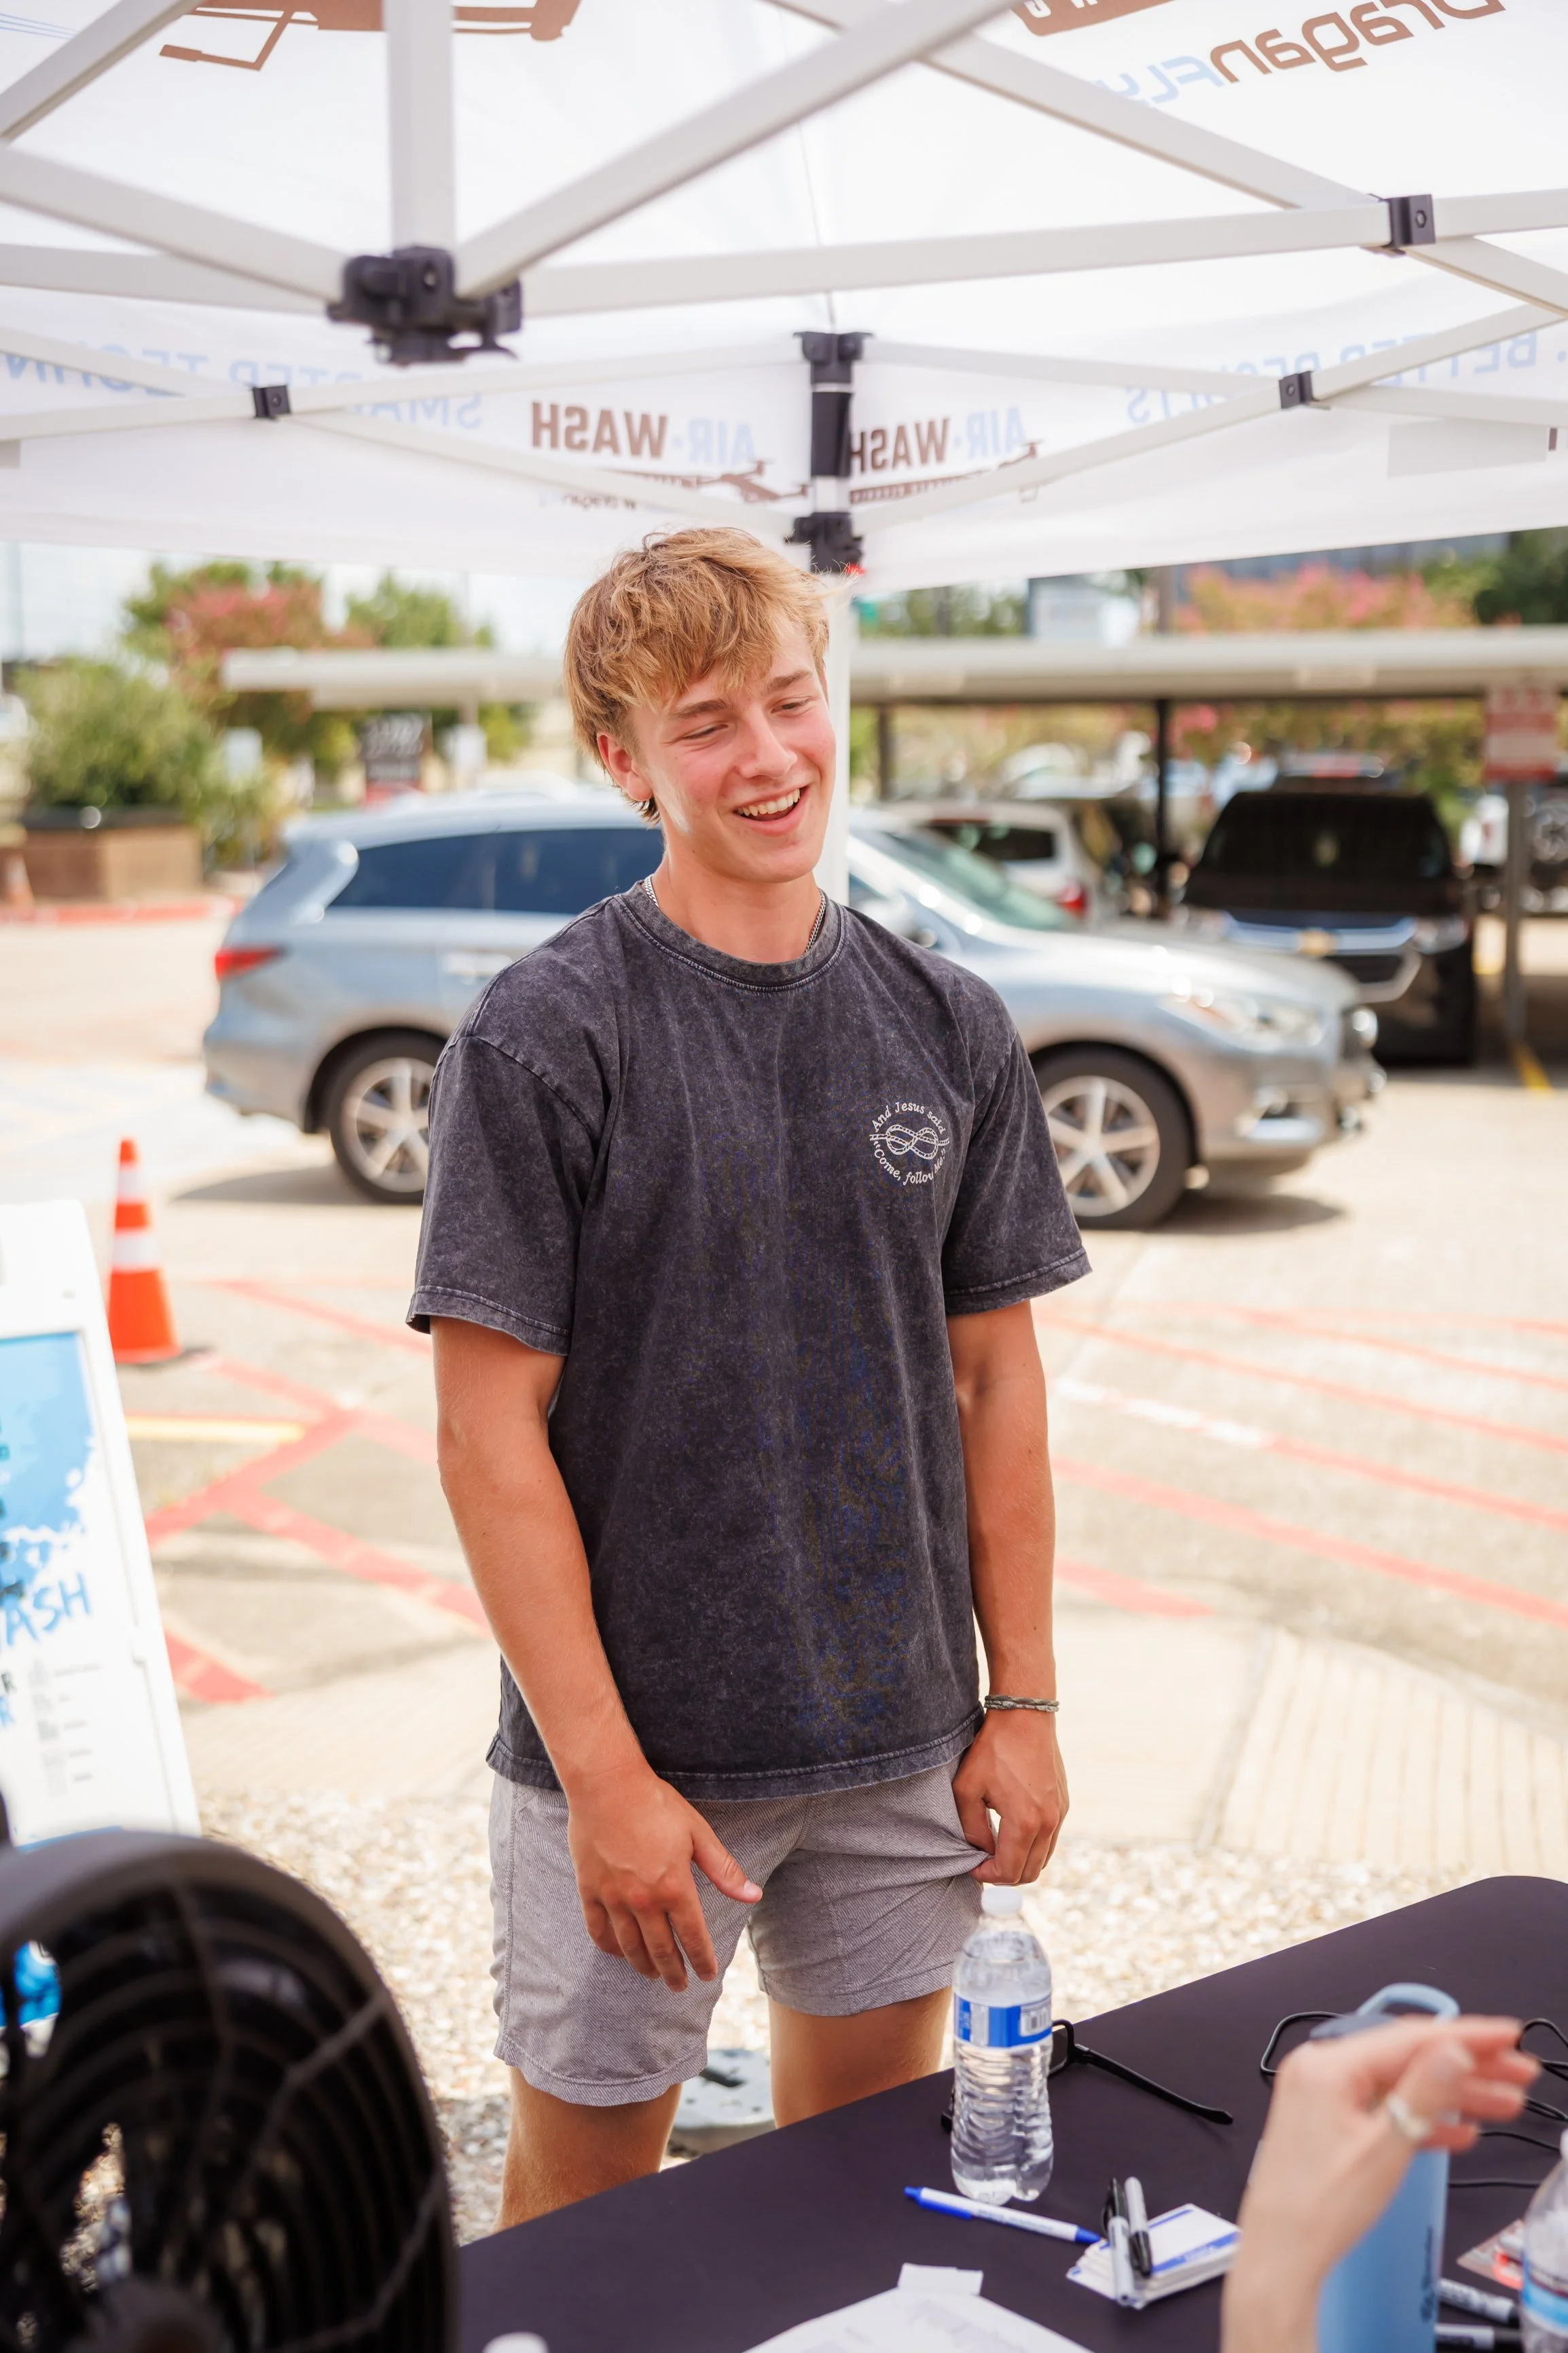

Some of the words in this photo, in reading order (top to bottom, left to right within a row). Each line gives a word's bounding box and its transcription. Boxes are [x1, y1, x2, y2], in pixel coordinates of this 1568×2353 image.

[872, 1105, 892, 1132] And
[895, 1101, 925, 1115] Jesus
[927, 1111, 946, 1134] said
[0, 1571, 90, 1647] ASH
